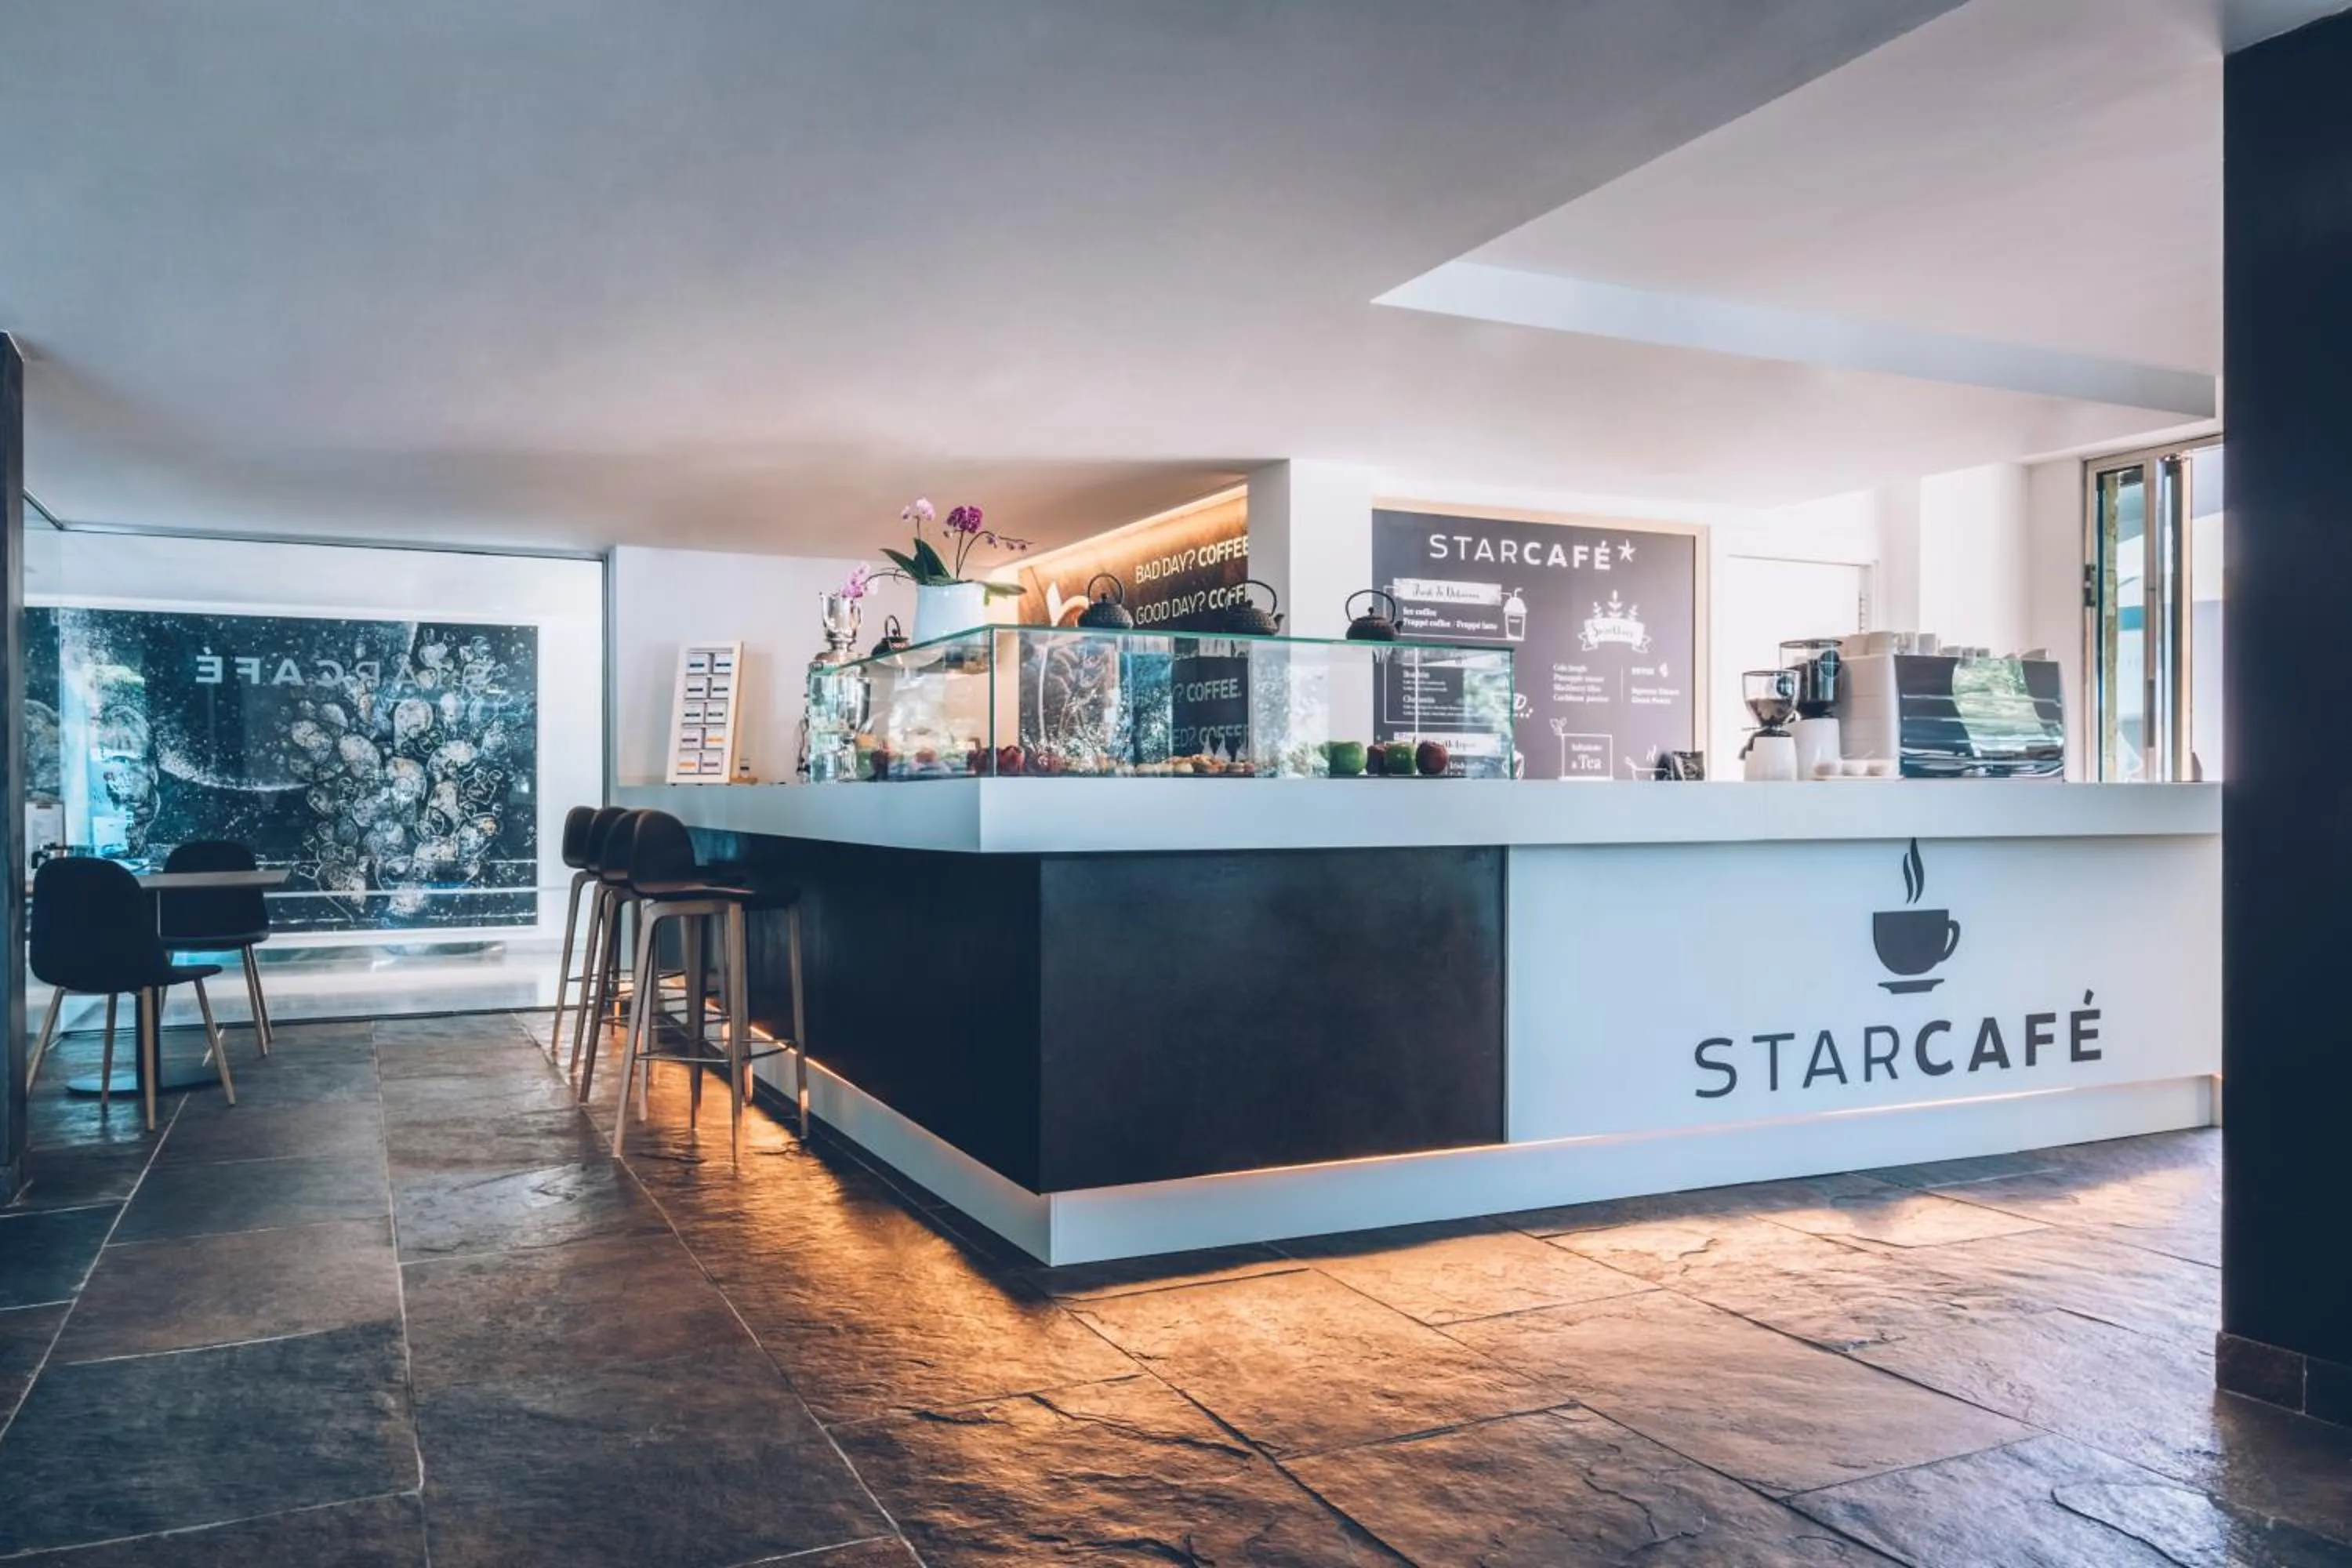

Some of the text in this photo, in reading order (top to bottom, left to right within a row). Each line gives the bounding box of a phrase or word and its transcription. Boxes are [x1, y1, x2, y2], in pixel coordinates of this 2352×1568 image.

[1136, 561, 1160, 584] BAD
[1163, 550, 1196, 578] DAY?
[1429, 533, 1611, 571] STARCAFÉ
[1136, 601, 1170, 625] GOOD
[1172, 591, 1206, 617] DAY?
[1694, 989, 2102, 1098] STARCAFÉ
